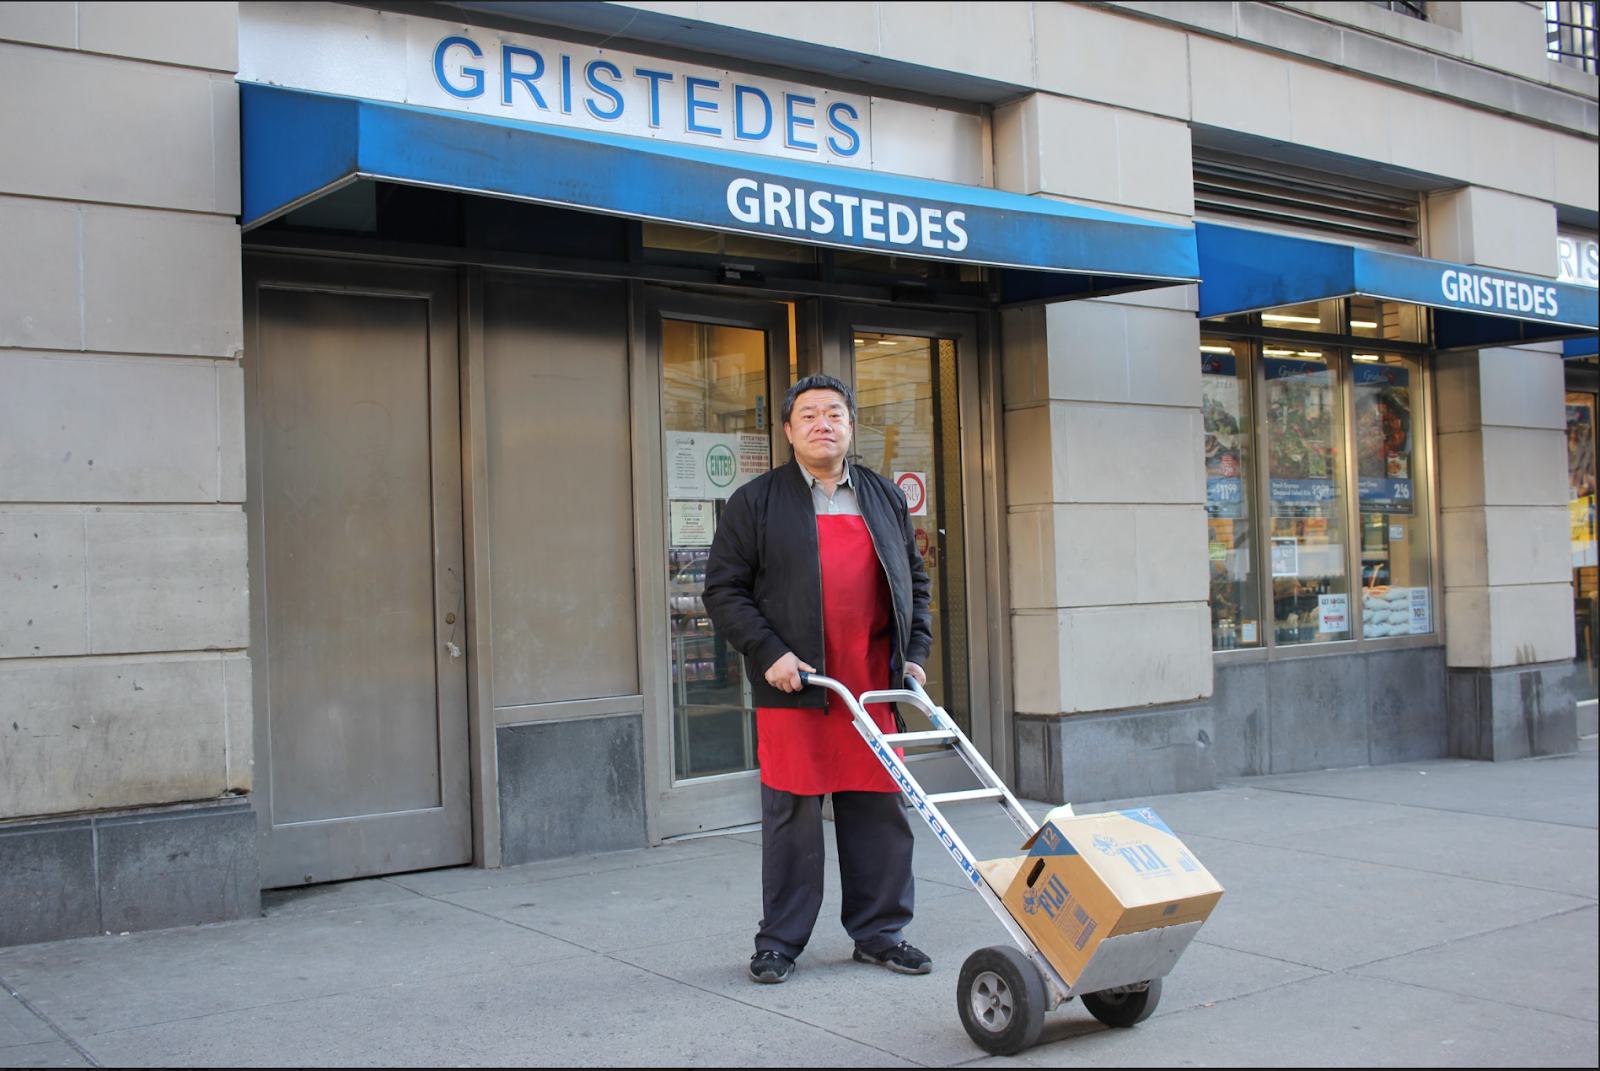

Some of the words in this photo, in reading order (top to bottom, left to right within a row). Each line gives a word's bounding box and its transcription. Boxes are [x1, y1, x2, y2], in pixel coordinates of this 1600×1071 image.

[432, 35, 862, 158] GRISTEDES
[726, 177, 969, 253] GRISTEDES
[1441, 269, 1558, 317] GRISTEDES
[710, 455, 732, 476] ENTER
[902, 484, 918, 492] EXIT
[906, 492, 920, 501] NLY
[1137, 809, 1156, 821] 12
[1042, 827, 1057, 846] 12
[1118, 844, 1168, 873] FIJI
[1038, 873, 1070, 919] FIJI
